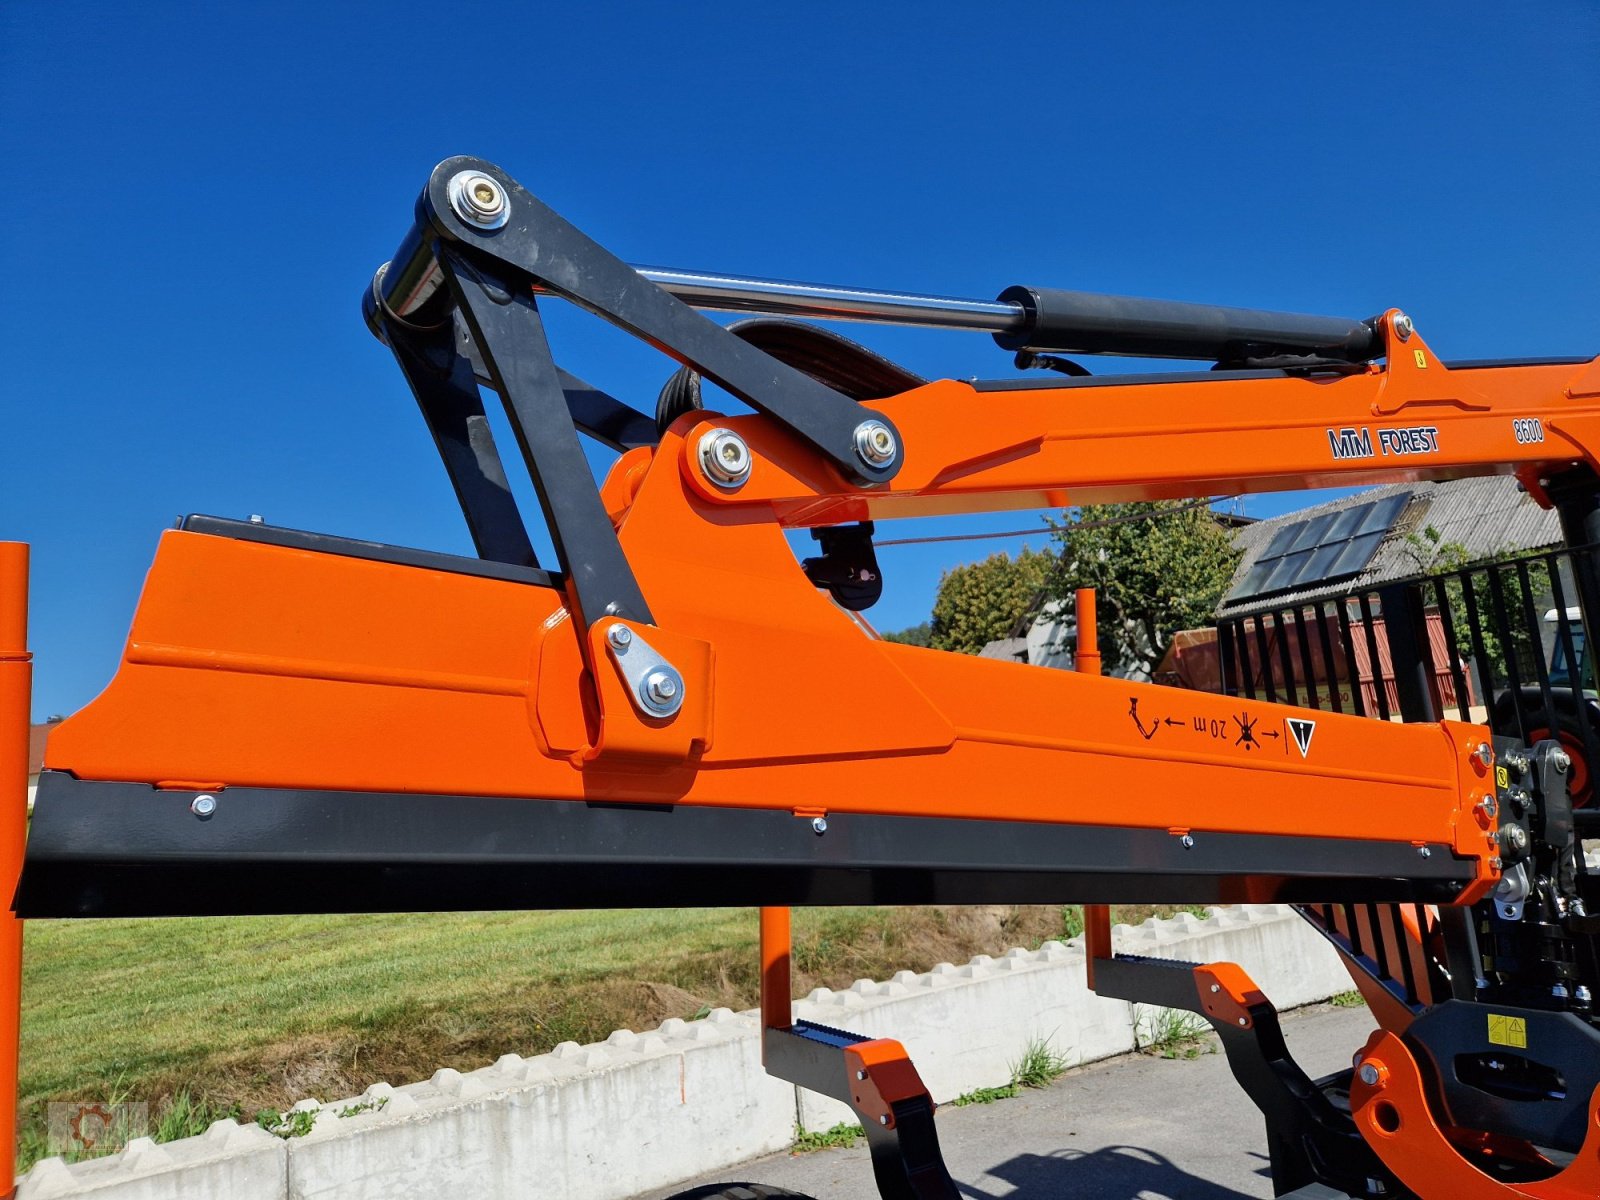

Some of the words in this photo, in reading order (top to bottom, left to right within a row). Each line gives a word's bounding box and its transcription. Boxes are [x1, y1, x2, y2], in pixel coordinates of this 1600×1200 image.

[1327, 428, 1374, 460] MTM
[1377, 426, 1439, 456] FOREST
[1513, 417, 1545, 445] 8600
[1193, 716, 1207, 733] m
[1210, 719, 1227, 739] 20
